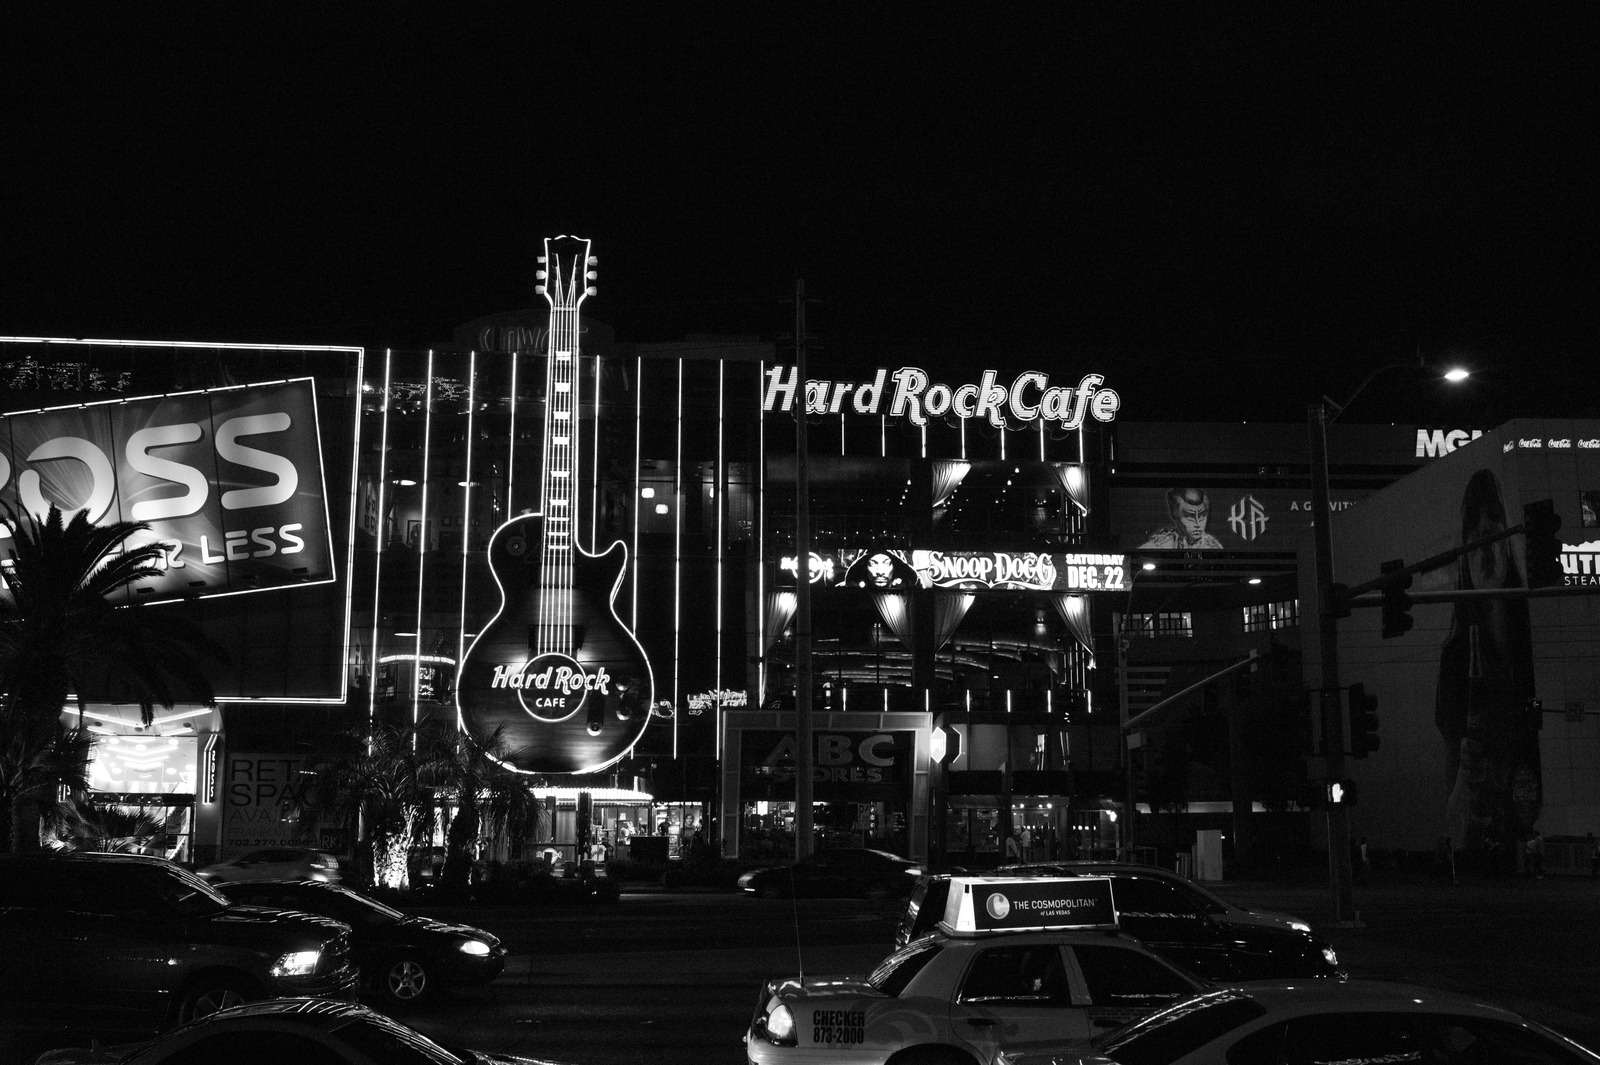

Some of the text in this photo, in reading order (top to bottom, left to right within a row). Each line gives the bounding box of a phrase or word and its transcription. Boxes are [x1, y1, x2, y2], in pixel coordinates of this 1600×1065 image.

[762, 366, 1121, 430] Hard Rock Cafe
[1416, 429, 1491, 458] MG
[0, 412, 298, 540] OSS
[1303, 501, 1357, 512] GVIT
[200, 522, 305, 565] LESS
[927, 551, 1057, 585] SNOOP DOGG
[1065, 553, 1125, 565] SATURDAY
[1067, 566, 1124, 588] DEC. 22
[1564, 576, 1600, 586] STEA
[491, 665, 610, 695] Hard Rock
[535, 697, 566, 708] CAFE
[762, 733, 895, 767] ABC
[770, 766, 882, 783] SORES
[1013, 899, 1095, 910] THE COSMOPOLITAN
[813, 1010, 865, 1026] CHECKER
[813, 1027, 864, 1043] 873-2000
